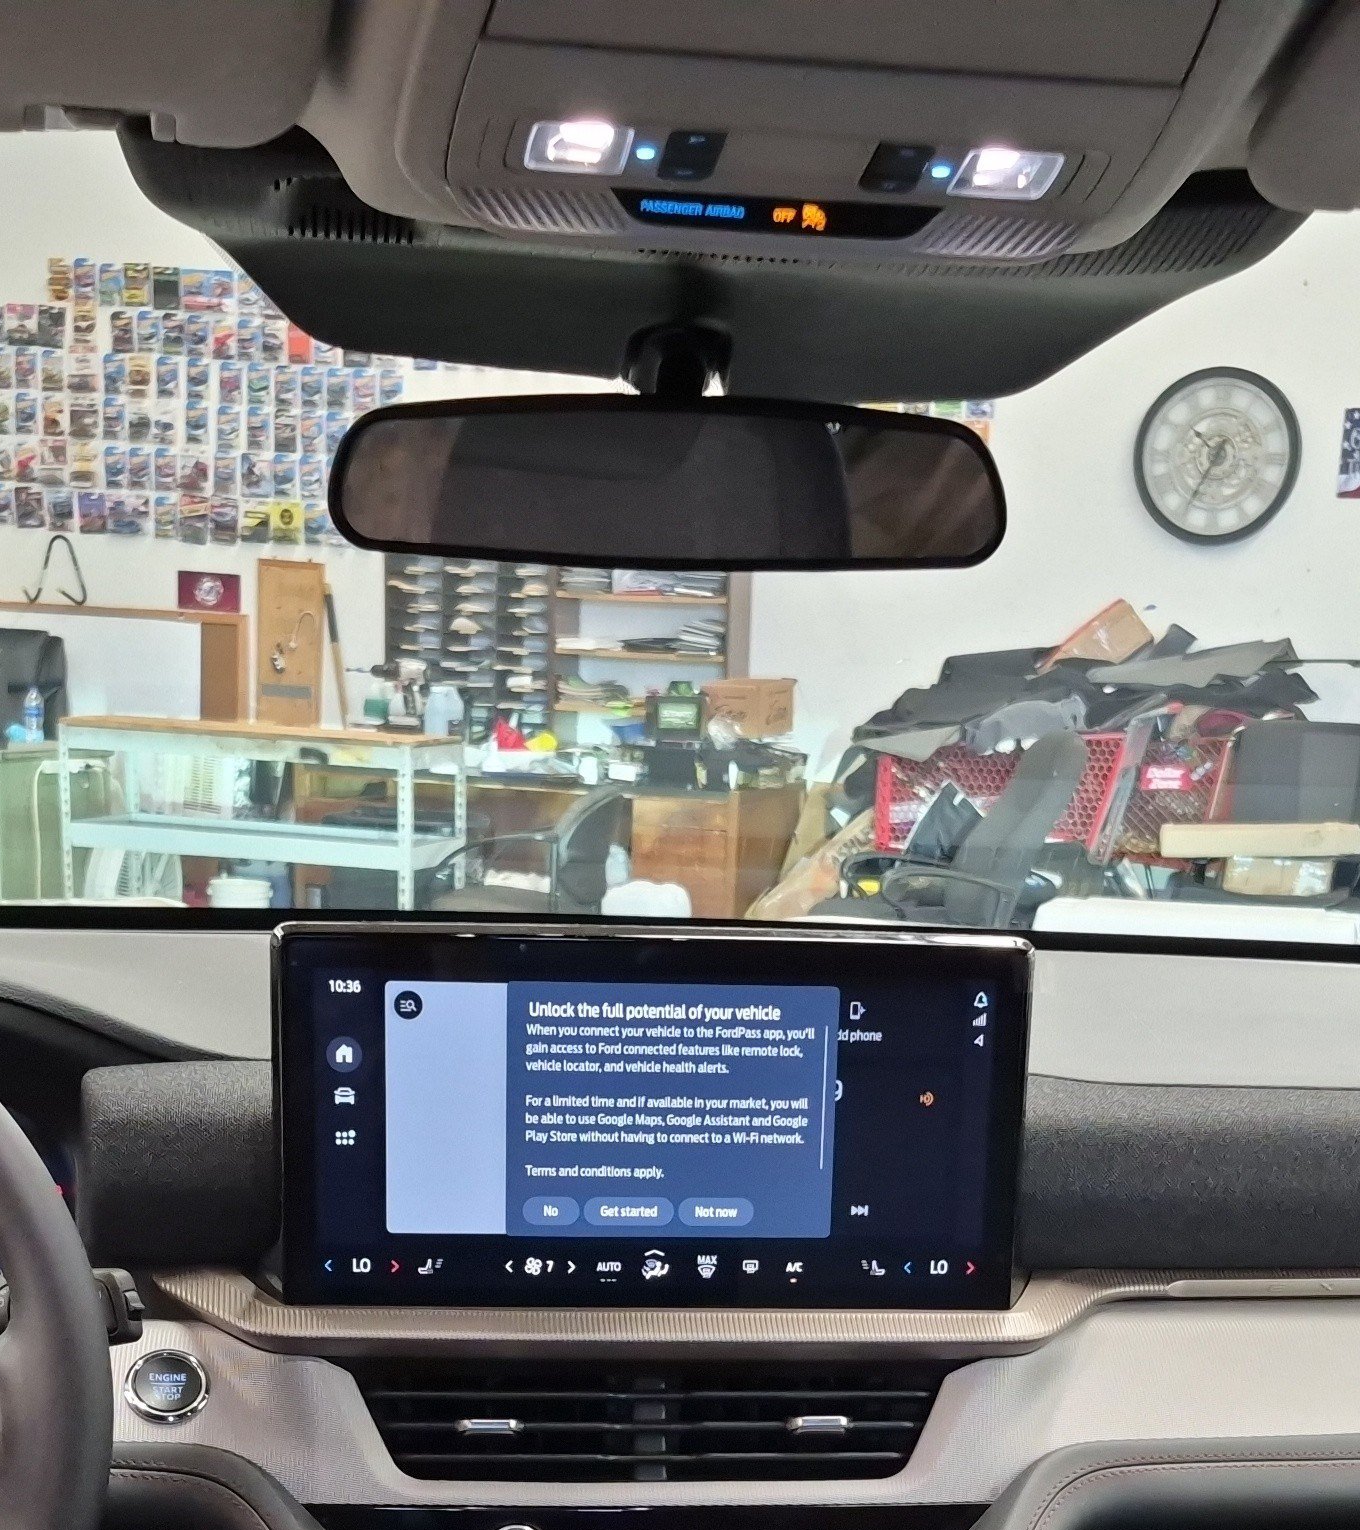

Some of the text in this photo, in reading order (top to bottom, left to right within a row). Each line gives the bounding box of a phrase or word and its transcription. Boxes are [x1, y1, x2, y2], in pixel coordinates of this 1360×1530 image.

[640, 199, 702, 216] PASSENGER
[772, 207, 798, 223] OFF
[328, 979, 362, 993] 10:36
[528, 1001, 781, 1022] Unlock the full potential of your vehicle
[526, 1023, 815, 1041] When you connect your vehicle to the FordPass app, you'll
[837, 1029, 882, 1043] dd phone
[525, 1042, 803, 1058] gain access to Ford connected features like remote lock,
[526, 1060, 729, 1074] vehicle locator, and vehicle health alerts.
[525, 1095, 808, 1111] For a limited time and if available in your market, you will
[525, 1112, 808, 1128] be able to use Google Maps, Google Assistant and Google
[525, 1130, 804, 1144] Play Store without having to connect to a Wi-Fi network.
[525, 1165, 664, 1180] Terms and conditions apply.
[543, 1205, 559, 1217] No
[600, 1205, 658, 1217] Get started
[695, 1206, 738, 1218] Not now
[352, 1258, 371, 1273] LO
[546, 1260, 554, 1273] 7
[596, 1261, 622, 1272] AUTO
[697, 1255, 717, 1264] MAX
[785, 1262, 803, 1272] A/C
[929, 1260, 948, 1275] LO
[149, 1373, 187, 1382] ENGINE
